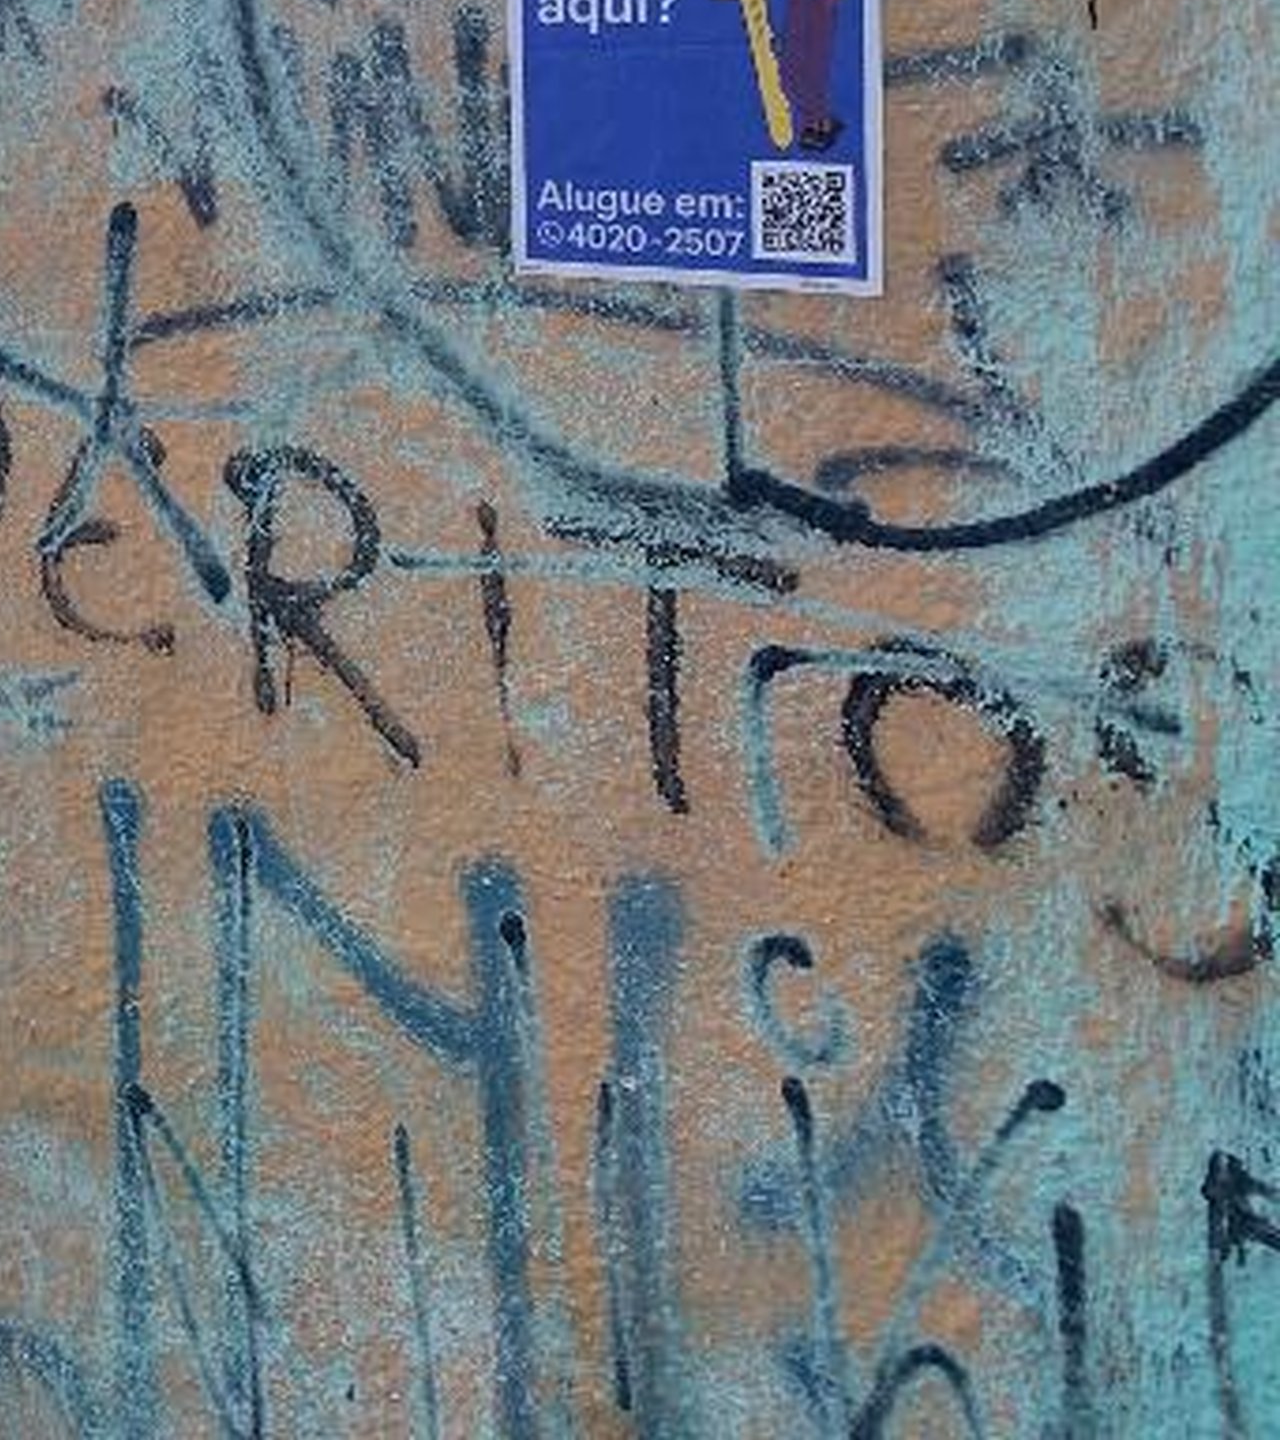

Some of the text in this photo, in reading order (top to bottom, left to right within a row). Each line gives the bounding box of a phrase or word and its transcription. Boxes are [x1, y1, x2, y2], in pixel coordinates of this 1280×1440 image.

[537, 179, 745, 221] Alugue em:
[568, 222, 745, 257] 4020-2507
